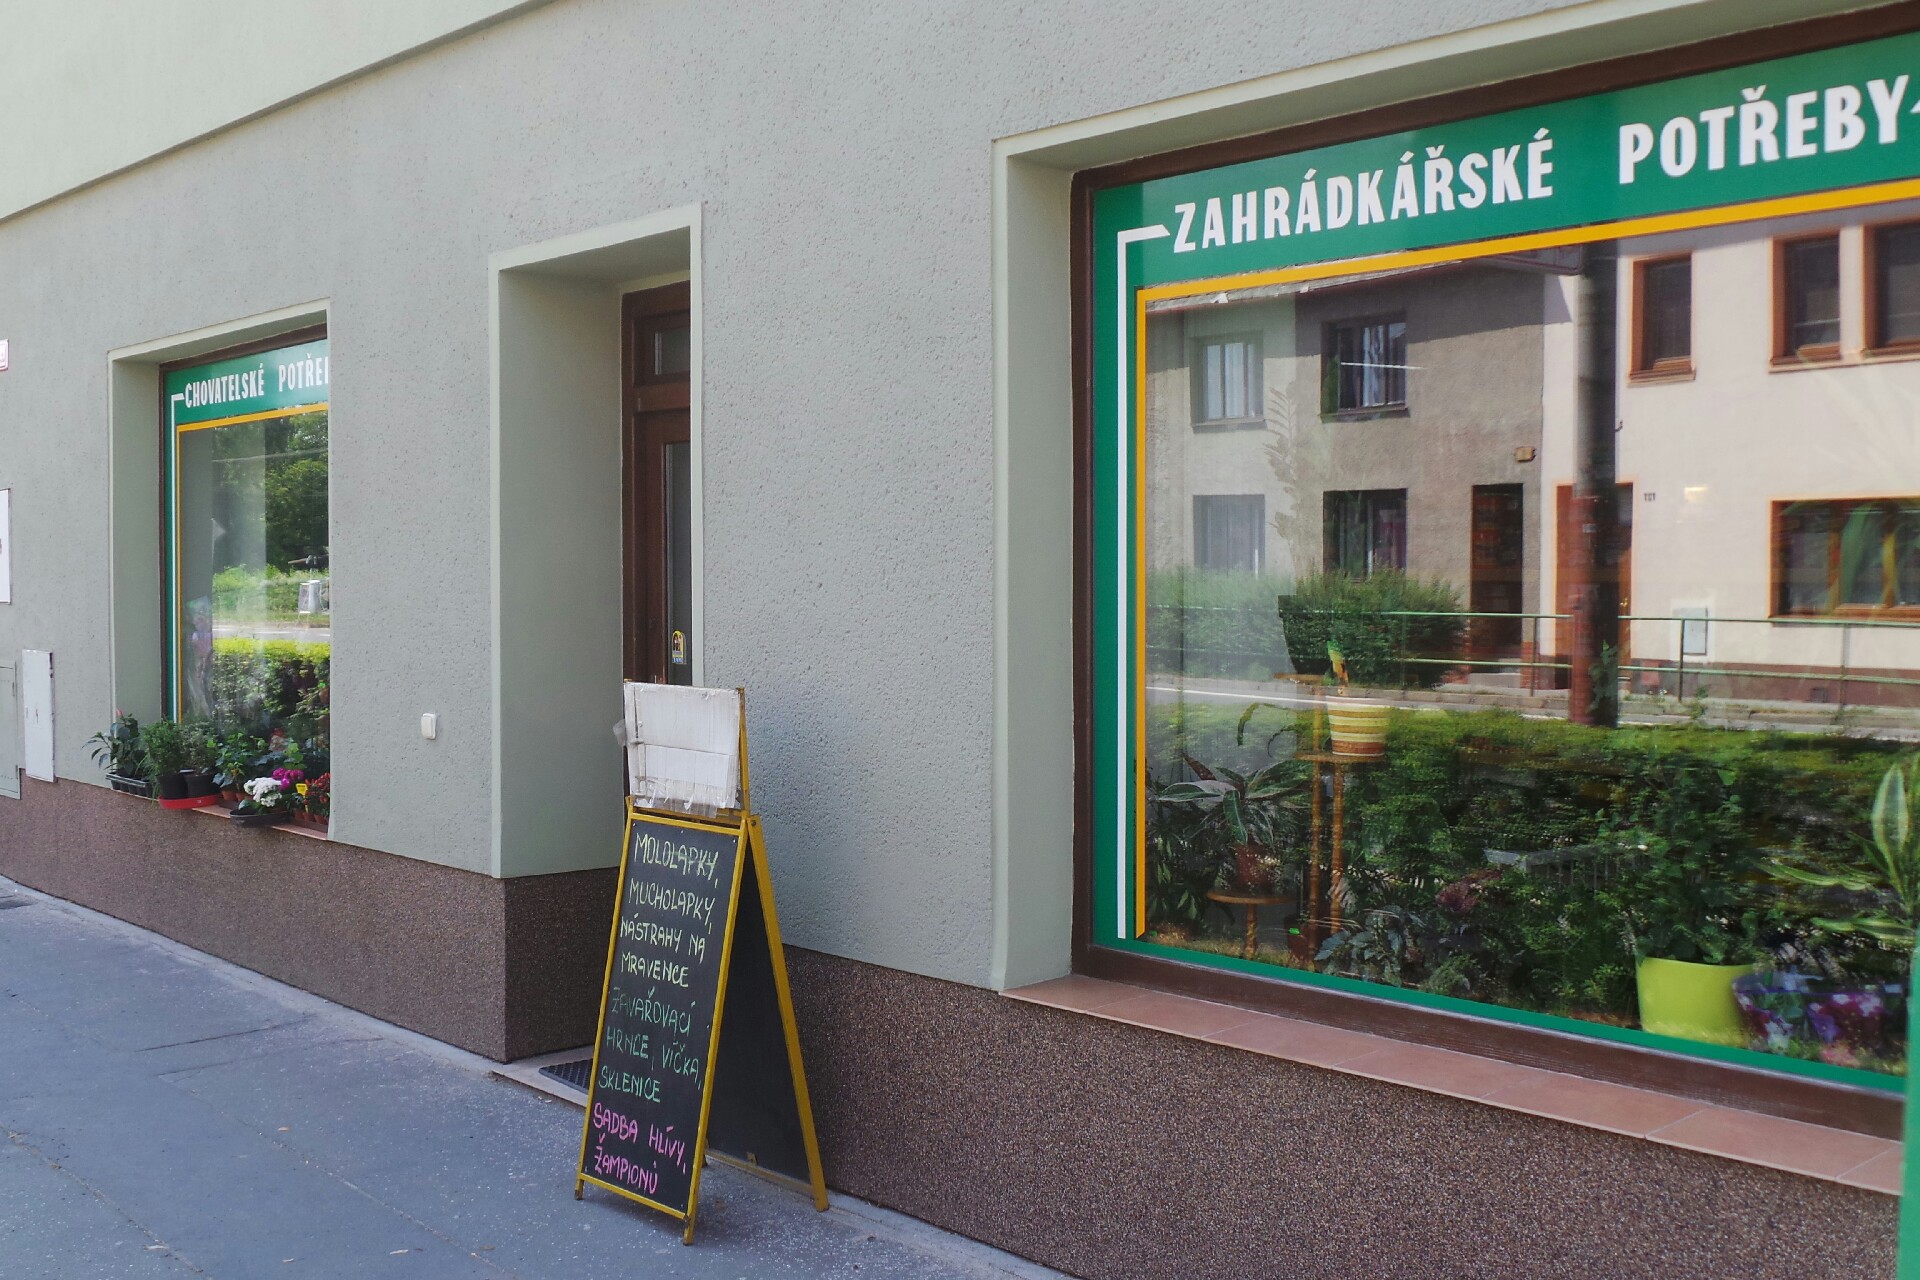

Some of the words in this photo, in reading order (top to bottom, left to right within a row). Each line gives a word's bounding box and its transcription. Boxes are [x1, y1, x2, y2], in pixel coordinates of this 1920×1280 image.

[1173, 127, 1554, 254] ZAHRÁDKÁŘSKÉ
[1618, 74, 1910, 184] POTŘEBY
[185, 363, 265, 408] CHOVATELSKÉ
[619, 912, 683, 954] NÁSTRAHY
[688, 934, 706, 965] NA
[620, 951, 689, 988] MRAVENCE
[598, 1065, 661, 1103] SKLENICE
[592, 1102, 638, 1144] SADBA
